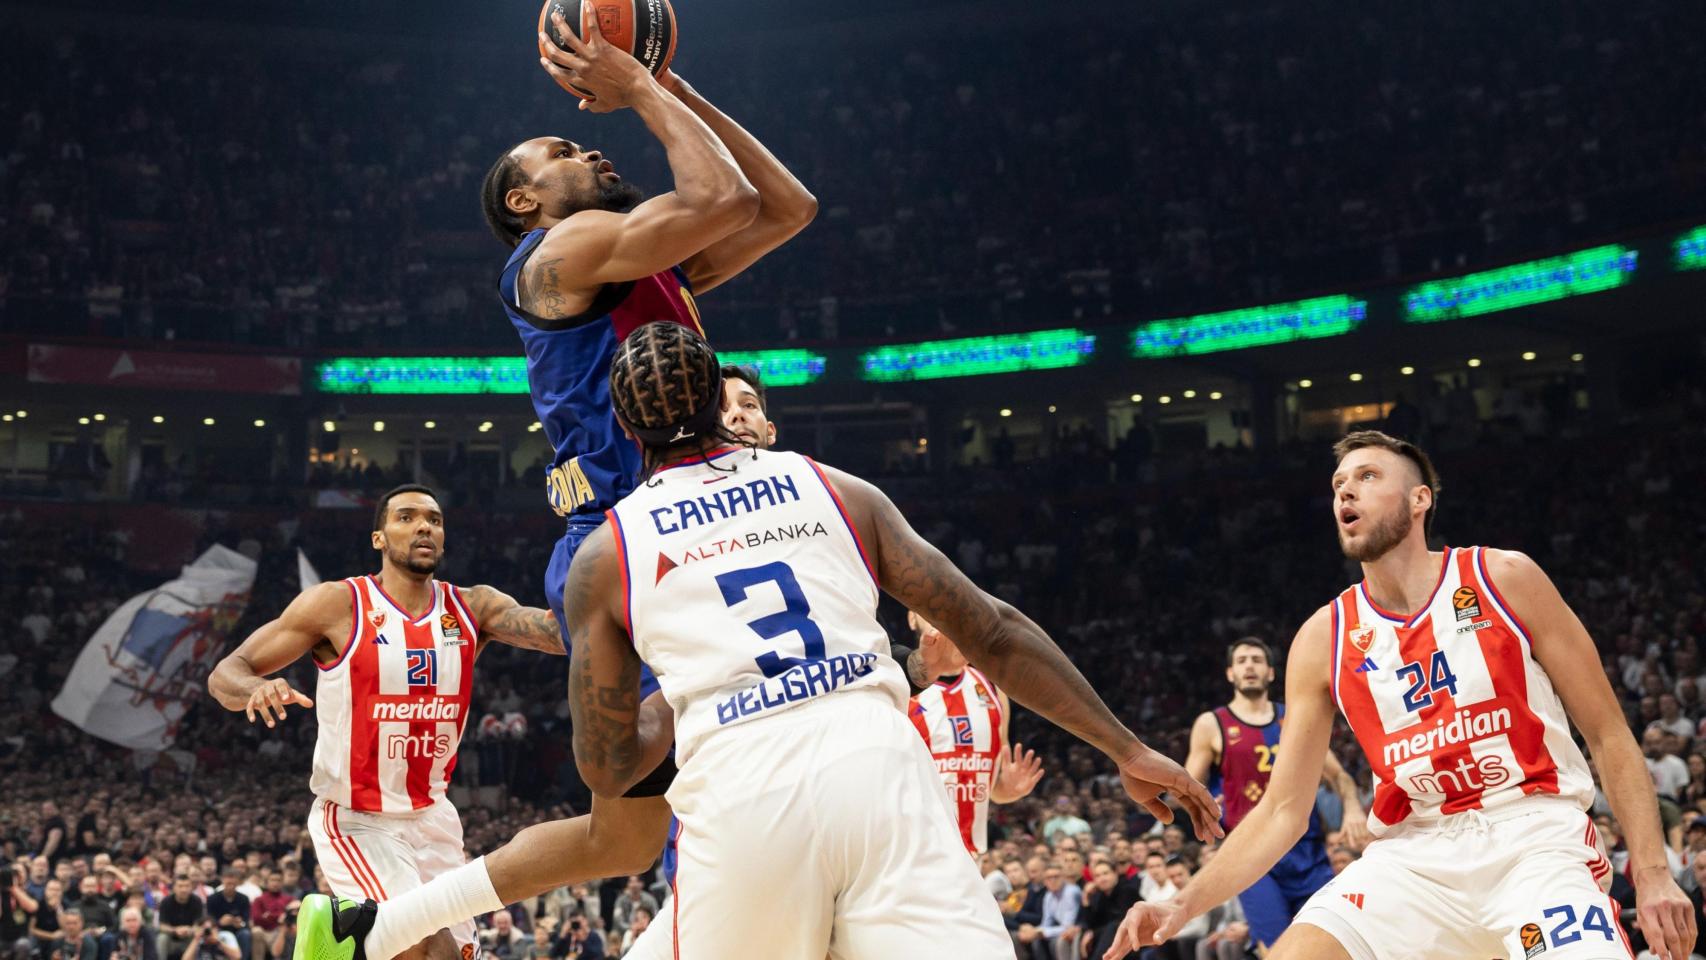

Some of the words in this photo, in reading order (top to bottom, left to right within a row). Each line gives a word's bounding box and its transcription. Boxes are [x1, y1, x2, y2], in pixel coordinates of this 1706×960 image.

[648, 40, 662, 71] AIRLIN
[649, 474, 801, 536] CANAAN
[684, 521, 828, 565] ALTABANKA
[714, 560, 826, 679] 3
[405, 648, 438, 686] 21
[1395, 650, 1458, 713] 24
[372, 697, 460, 719] meridian
[388, 730, 450, 759] mts
[947, 715, 974, 745] 12
[1383, 707, 1512, 766] meridian
[1409, 754, 1509, 793] mts
[1543, 904, 1615, 948] 24
